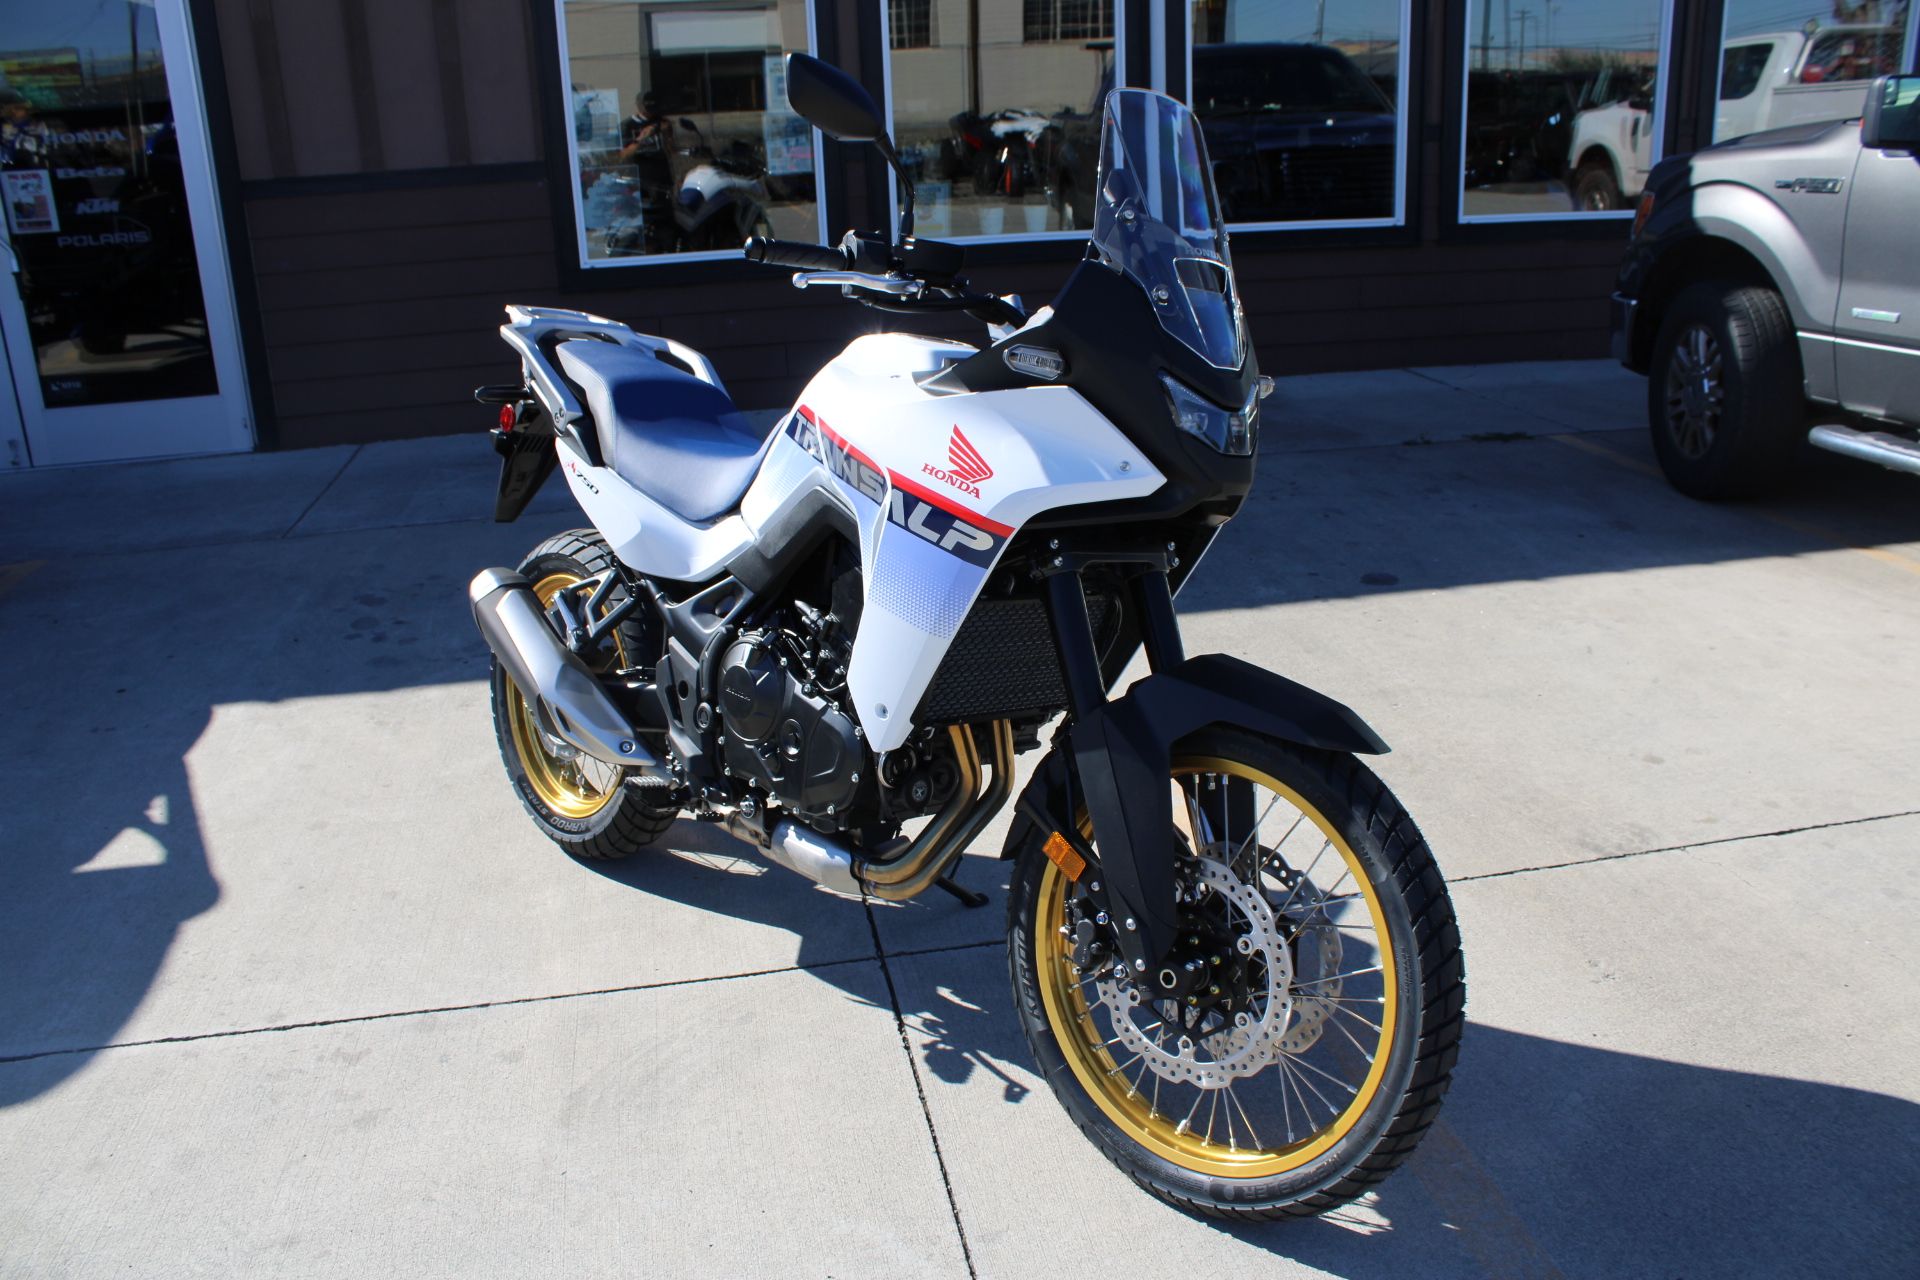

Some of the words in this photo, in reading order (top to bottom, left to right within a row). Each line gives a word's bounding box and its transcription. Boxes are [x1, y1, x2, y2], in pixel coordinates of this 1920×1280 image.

[43, 129, 126, 145] HONDA
[75, 198, 120, 215] KTM
[57, 231, 150, 248] POLARIS
[794, 411, 994, 551] TRANSALP
[921, 462, 982, 500] HONDA
